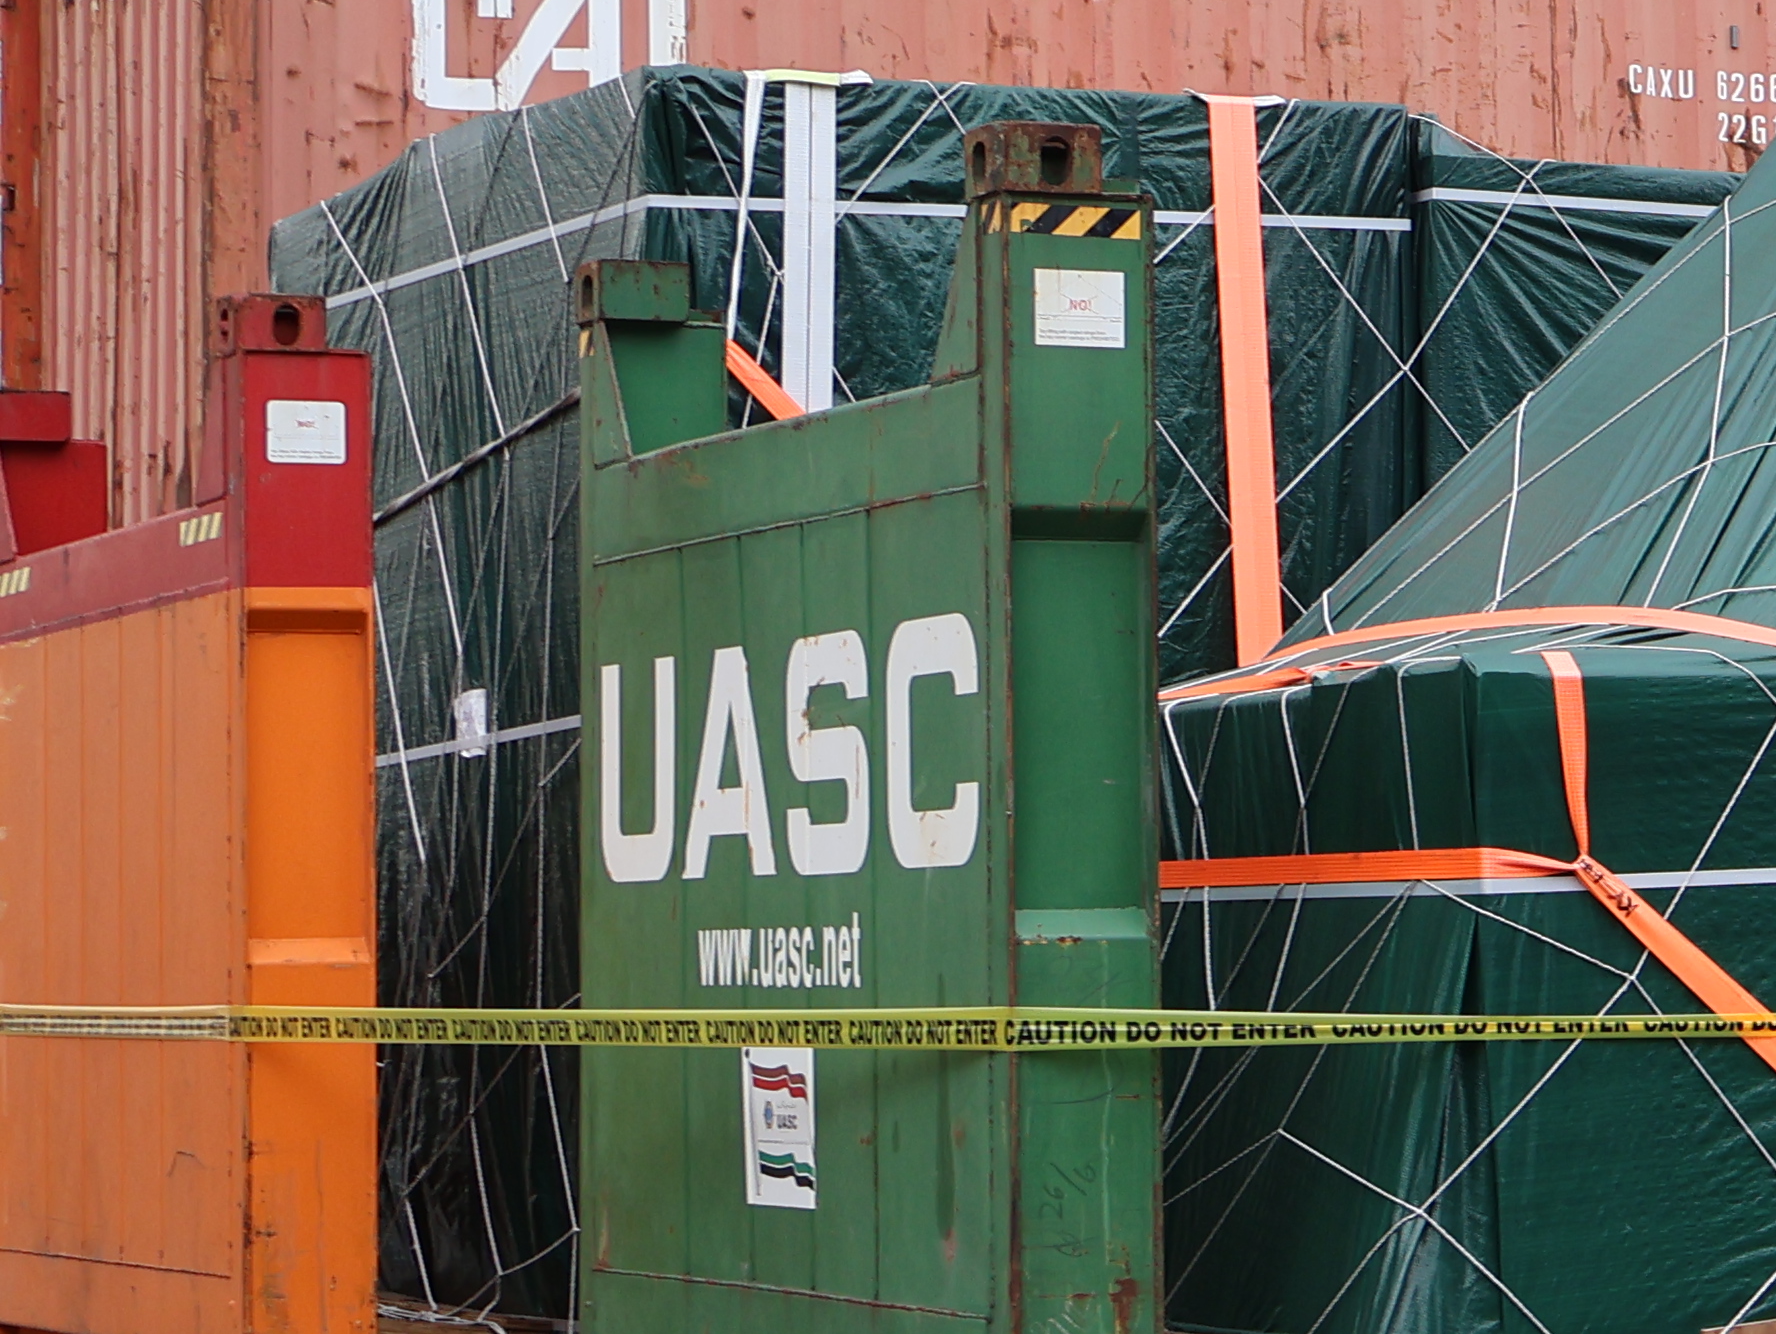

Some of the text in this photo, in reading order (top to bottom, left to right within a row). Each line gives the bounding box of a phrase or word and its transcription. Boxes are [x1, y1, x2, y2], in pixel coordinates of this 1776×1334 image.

[1627, 63, 1695, 100] CAXU
[600, 612, 980, 883] UASC
[698, 911, 862, 990] www.uasc.net
[706, 1019, 844, 1046] CAUTION DO NOT ENTER
[849, 1019, 999, 1046] CAUTION DO NOT ENTER
[1004, 1019, 1317, 1046] CAUTION DO NOT ENTER
